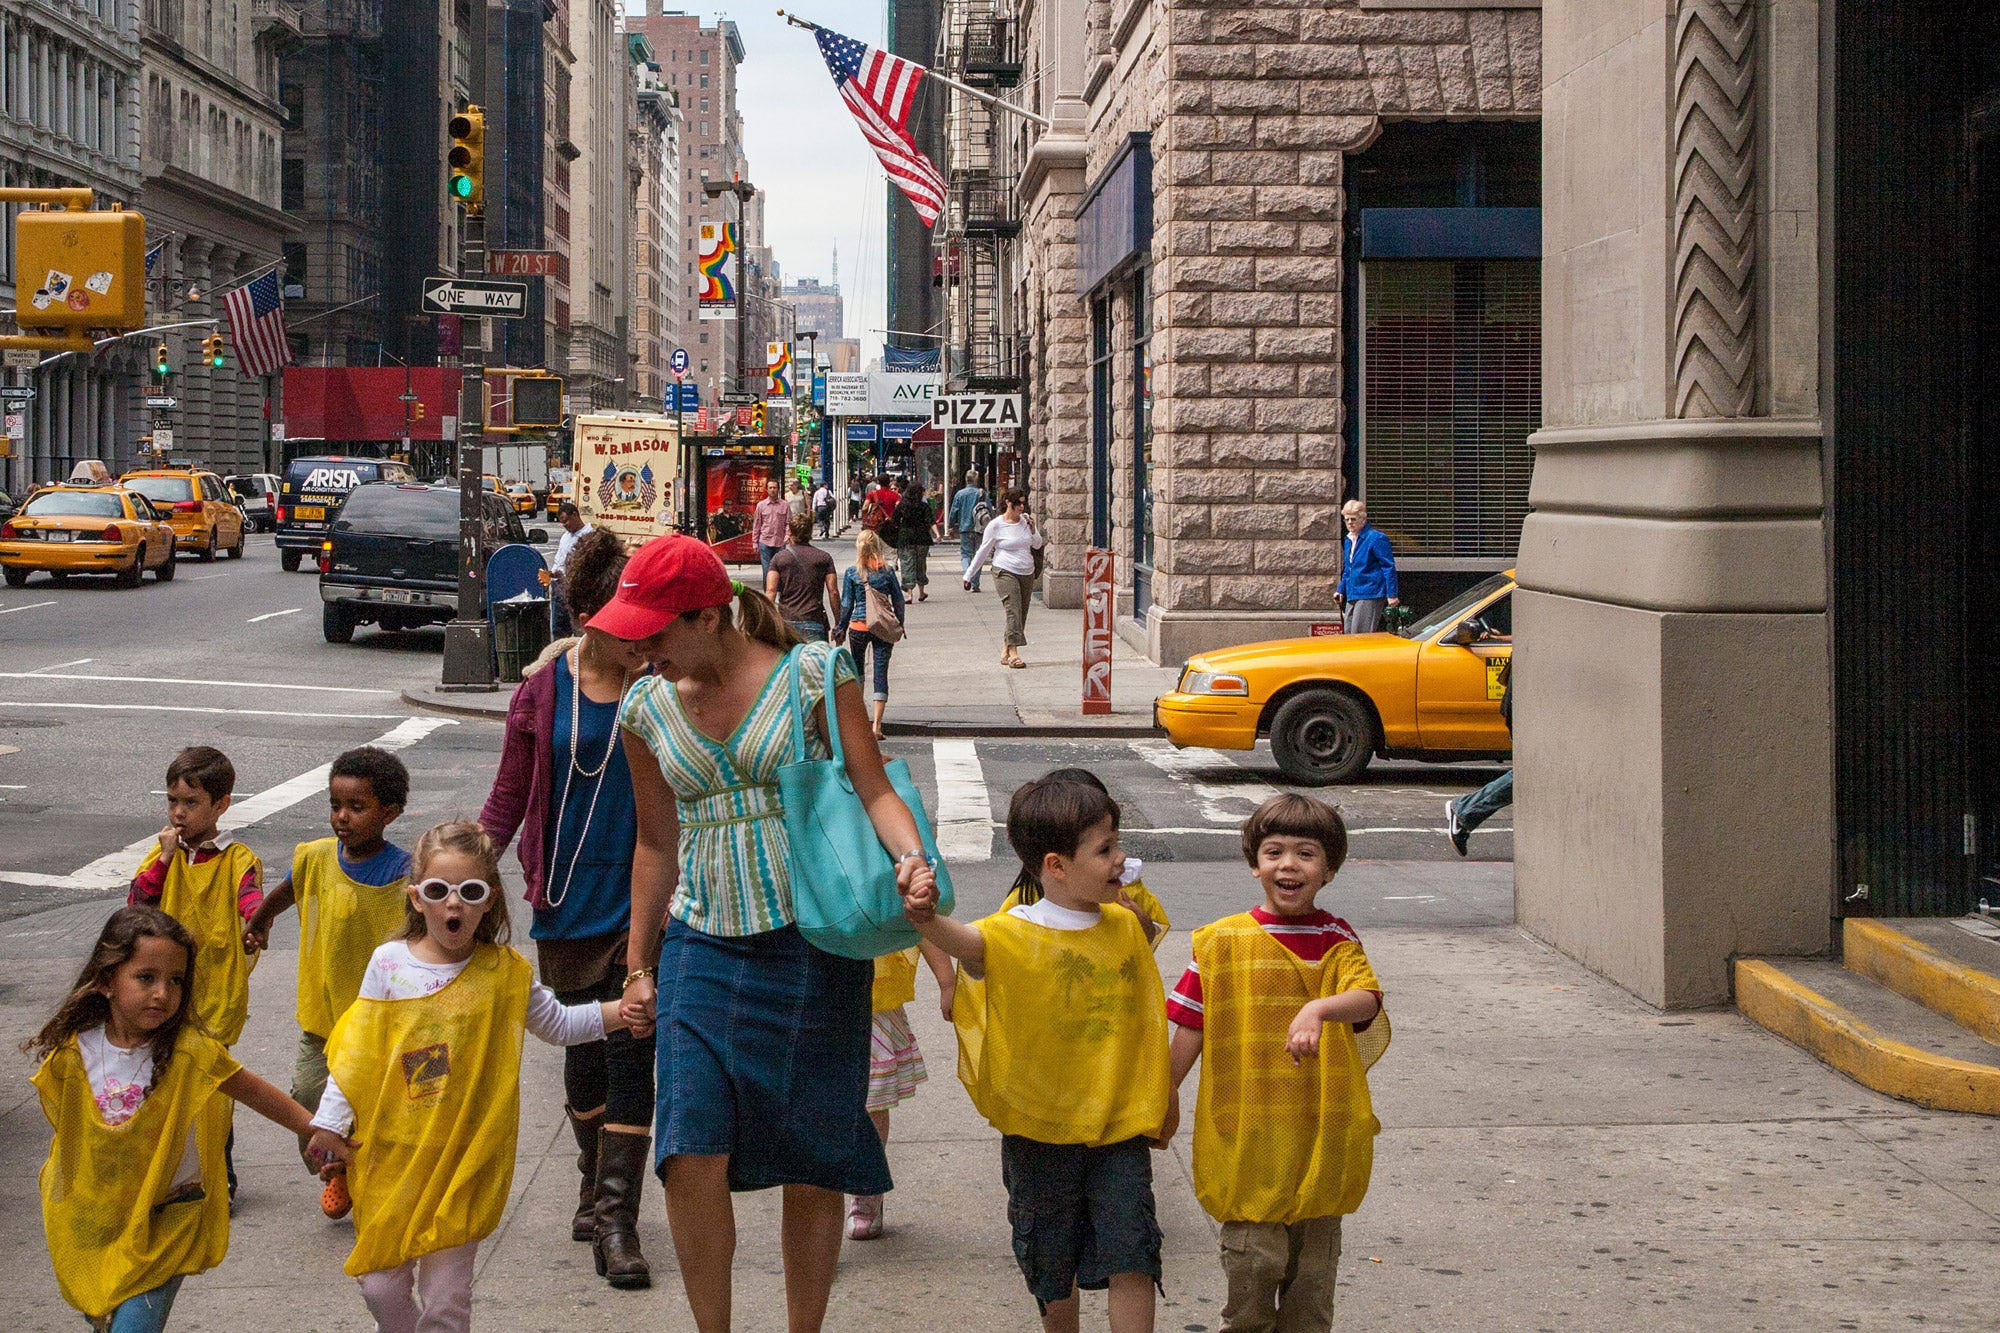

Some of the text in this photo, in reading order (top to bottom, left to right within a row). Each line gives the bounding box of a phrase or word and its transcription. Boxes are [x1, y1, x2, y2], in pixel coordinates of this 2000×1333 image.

[495, 254, 551, 276] W 20 ST
[437, 289, 514, 306] ONE WAY
[893, 384, 943, 399] AVE
[933, 398, 1019, 425] PIZZA
[302, 468, 362, 488] ARISTA
[595, 513, 655, 523] 1-888-WB-MASON
